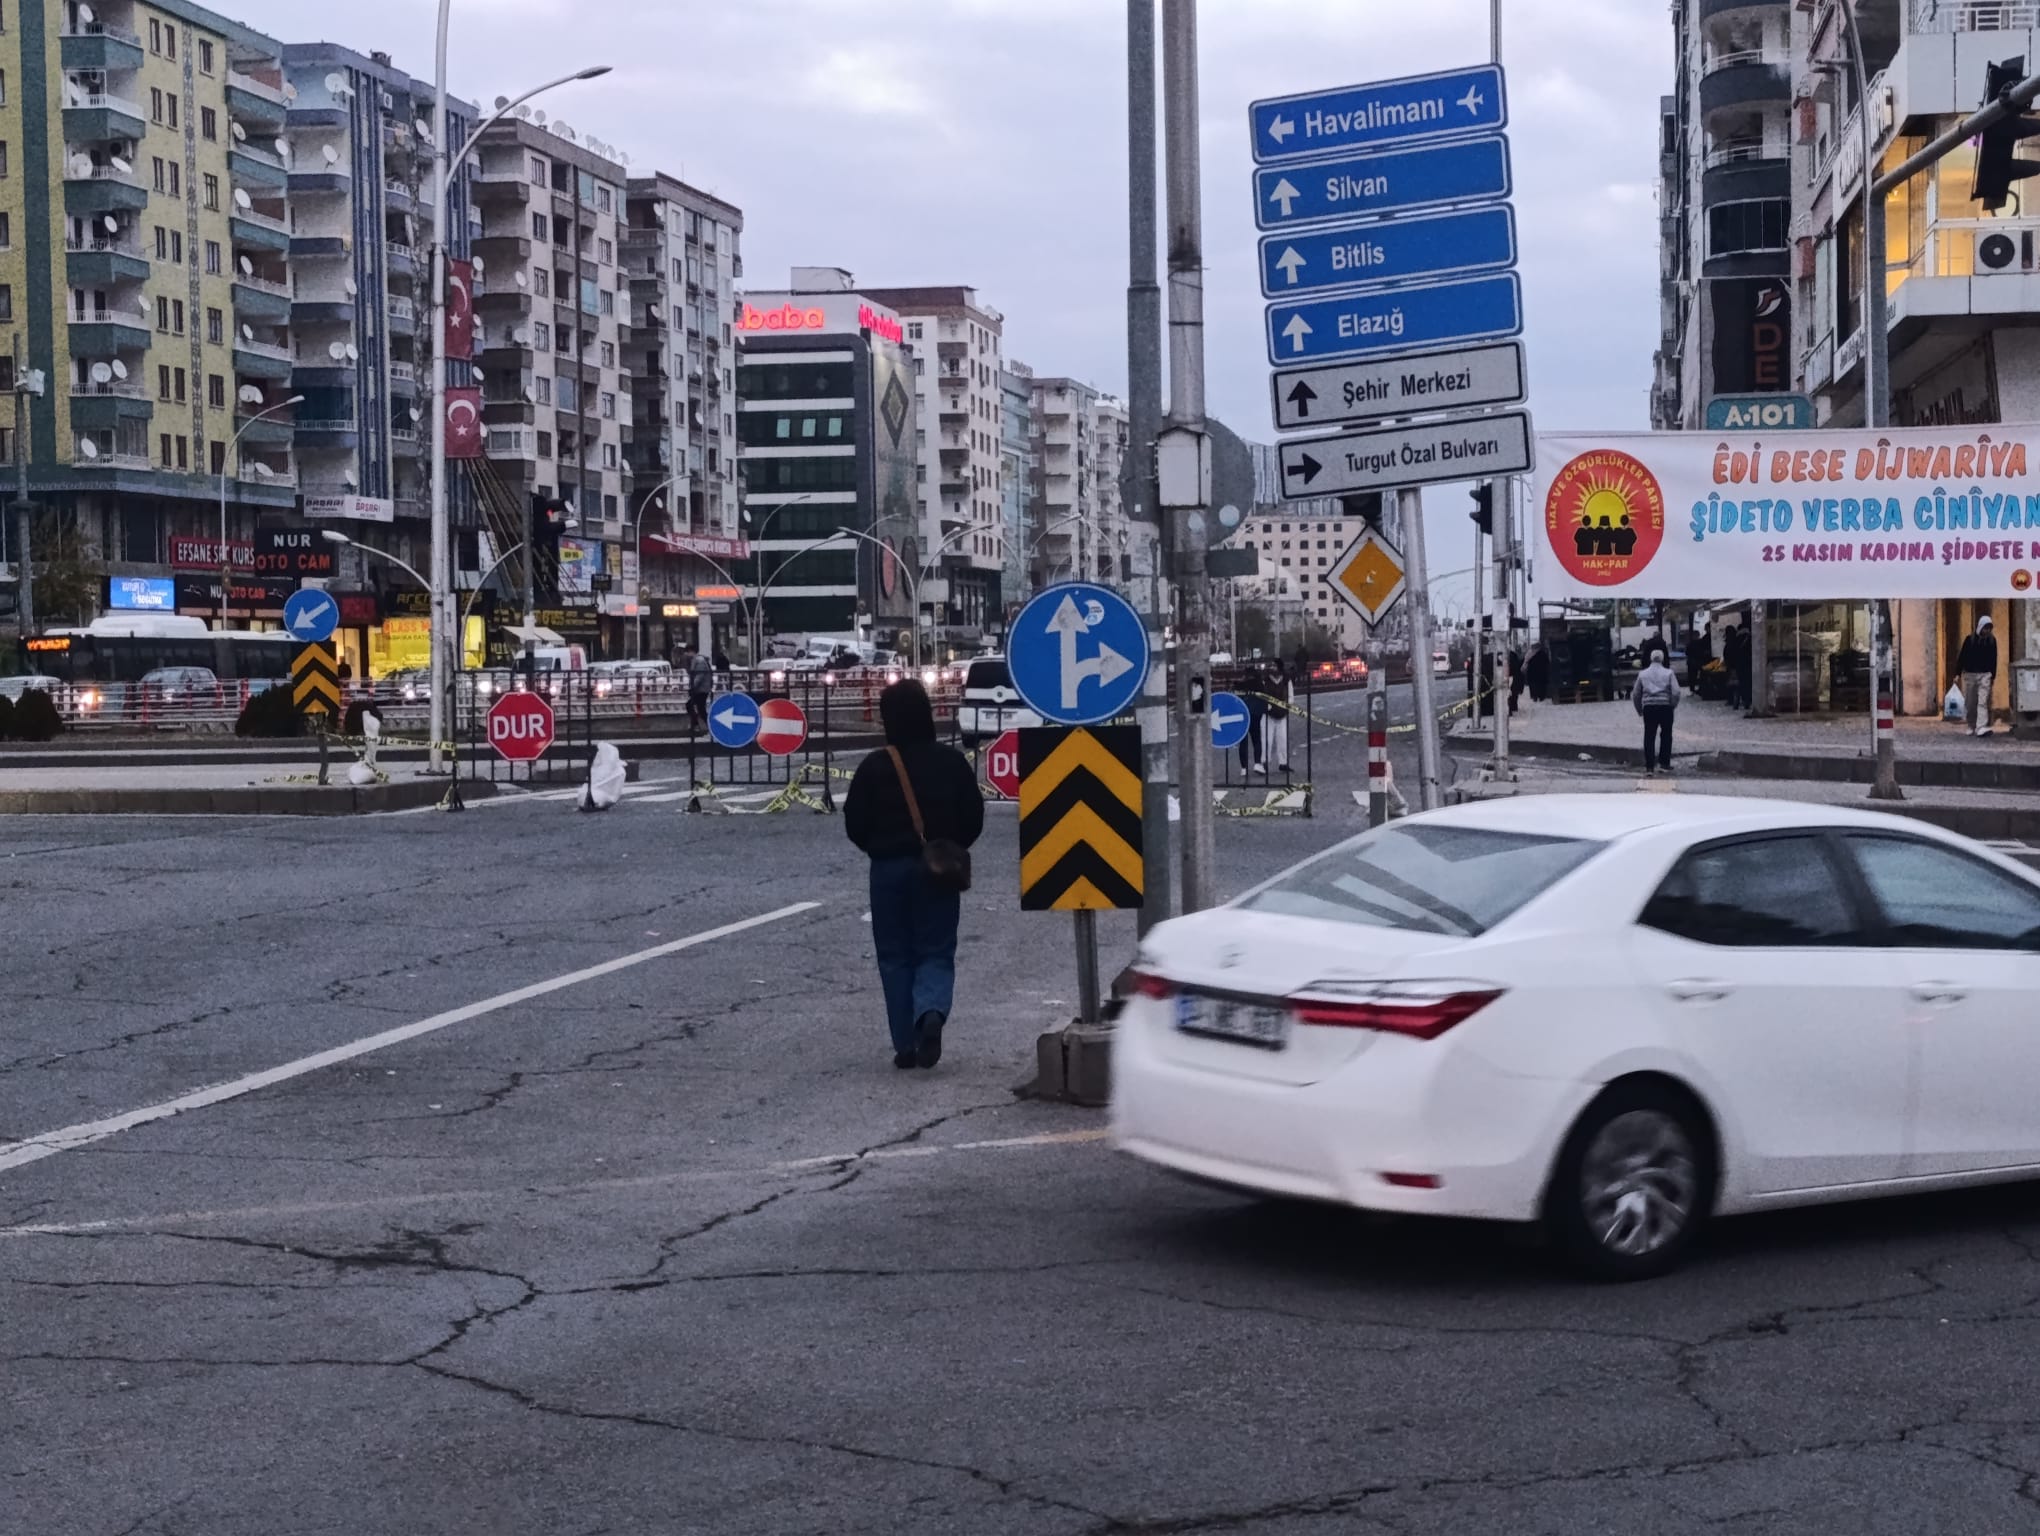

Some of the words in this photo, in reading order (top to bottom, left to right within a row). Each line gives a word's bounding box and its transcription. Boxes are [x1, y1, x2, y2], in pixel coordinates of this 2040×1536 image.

[1305, 98, 1445, 138] Havalimanı
[1326, 173, 1389, 202] Silvan
[1331, 242, 1386, 271] Bitlis
[1338, 307, 1405, 338] Elazığ
[1342, 378, 1390, 409] Şehir
[1400, 367, 1471, 398] Merkezi
[1345, 448, 1397, 475] Turgut
[1400, 440, 1437, 465] Özal
[1441, 436, 1499, 461] Bulvarı
[1564, 454, 1644, 483] ÖZGÜRLÜKLER
[1712, 442, 1761, 485] ÊDİ
[1770, 449, 1847, 483] BESE
[1553, 481, 1567, 498] VE
[1549, 501, 1558, 530] HAK
[1689, 491, 1794, 543] ŞÎDETO
[1802, 497, 1903, 532] VERBA
[178, 542, 212, 562] EFSANE
[273, 533, 312, 549] NUR
[1762, 545, 1786, 563] 25
[1792, 543, 1853, 562] KASIM
[1860, 542, 1935, 562] KADINA
[1941, 536, 2024, 566] ŞİDDETE
[256, 555, 289, 571] OTO
[297, 553, 332, 571] CAM
[1582, 559, 1629, 570] HAK-PAR
[493, 713, 546, 740] DUR
[993, 752, 1020, 777] DU
